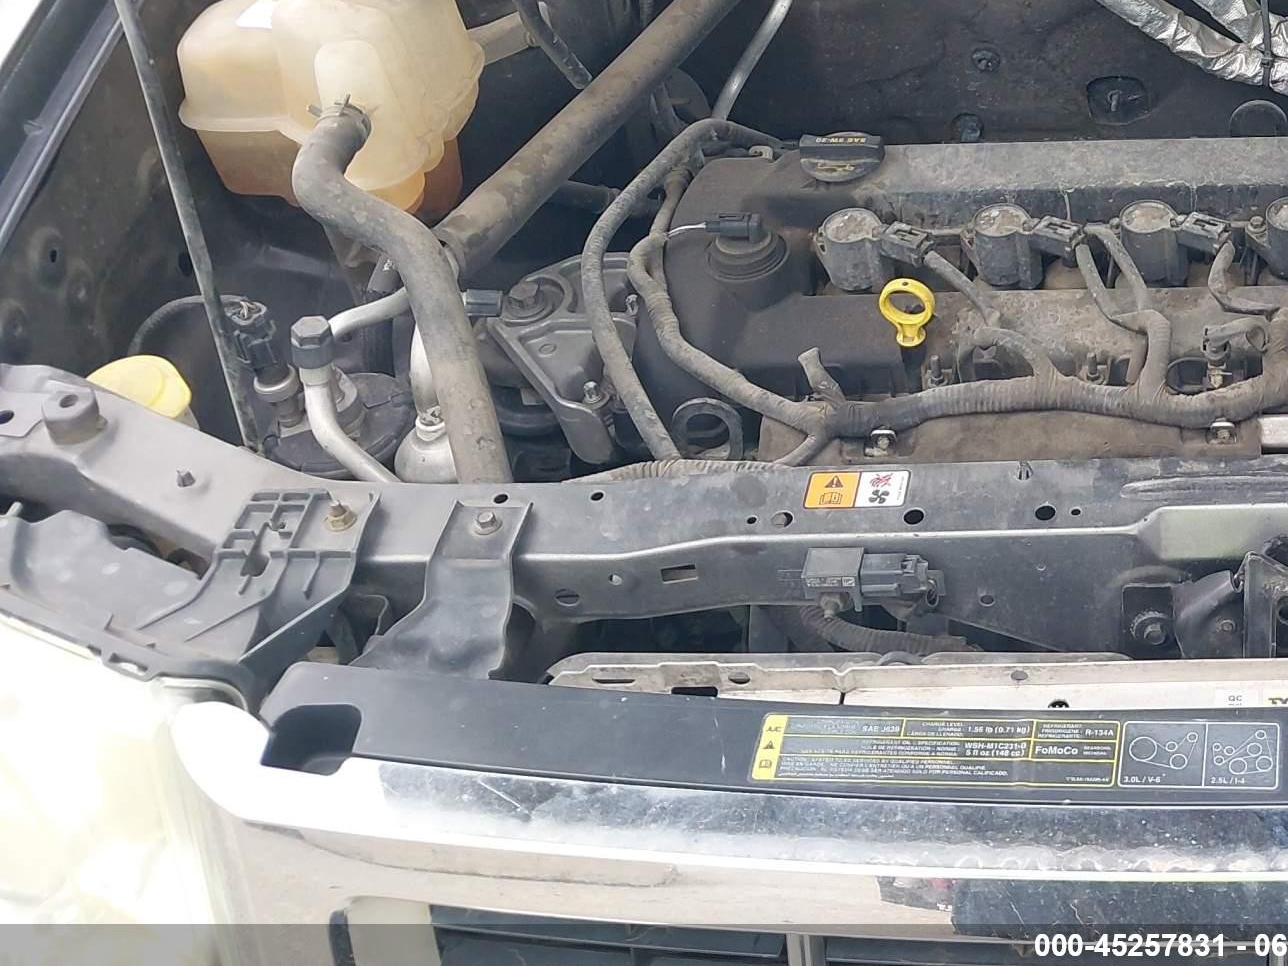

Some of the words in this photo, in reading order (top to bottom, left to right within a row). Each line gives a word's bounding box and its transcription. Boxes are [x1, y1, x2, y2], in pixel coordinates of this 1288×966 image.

[1228, 694, 1243, 702] QC
[1085, 728, 1114, 736] R-134A
[1035, 745, 1079, 755] FoMoCo
